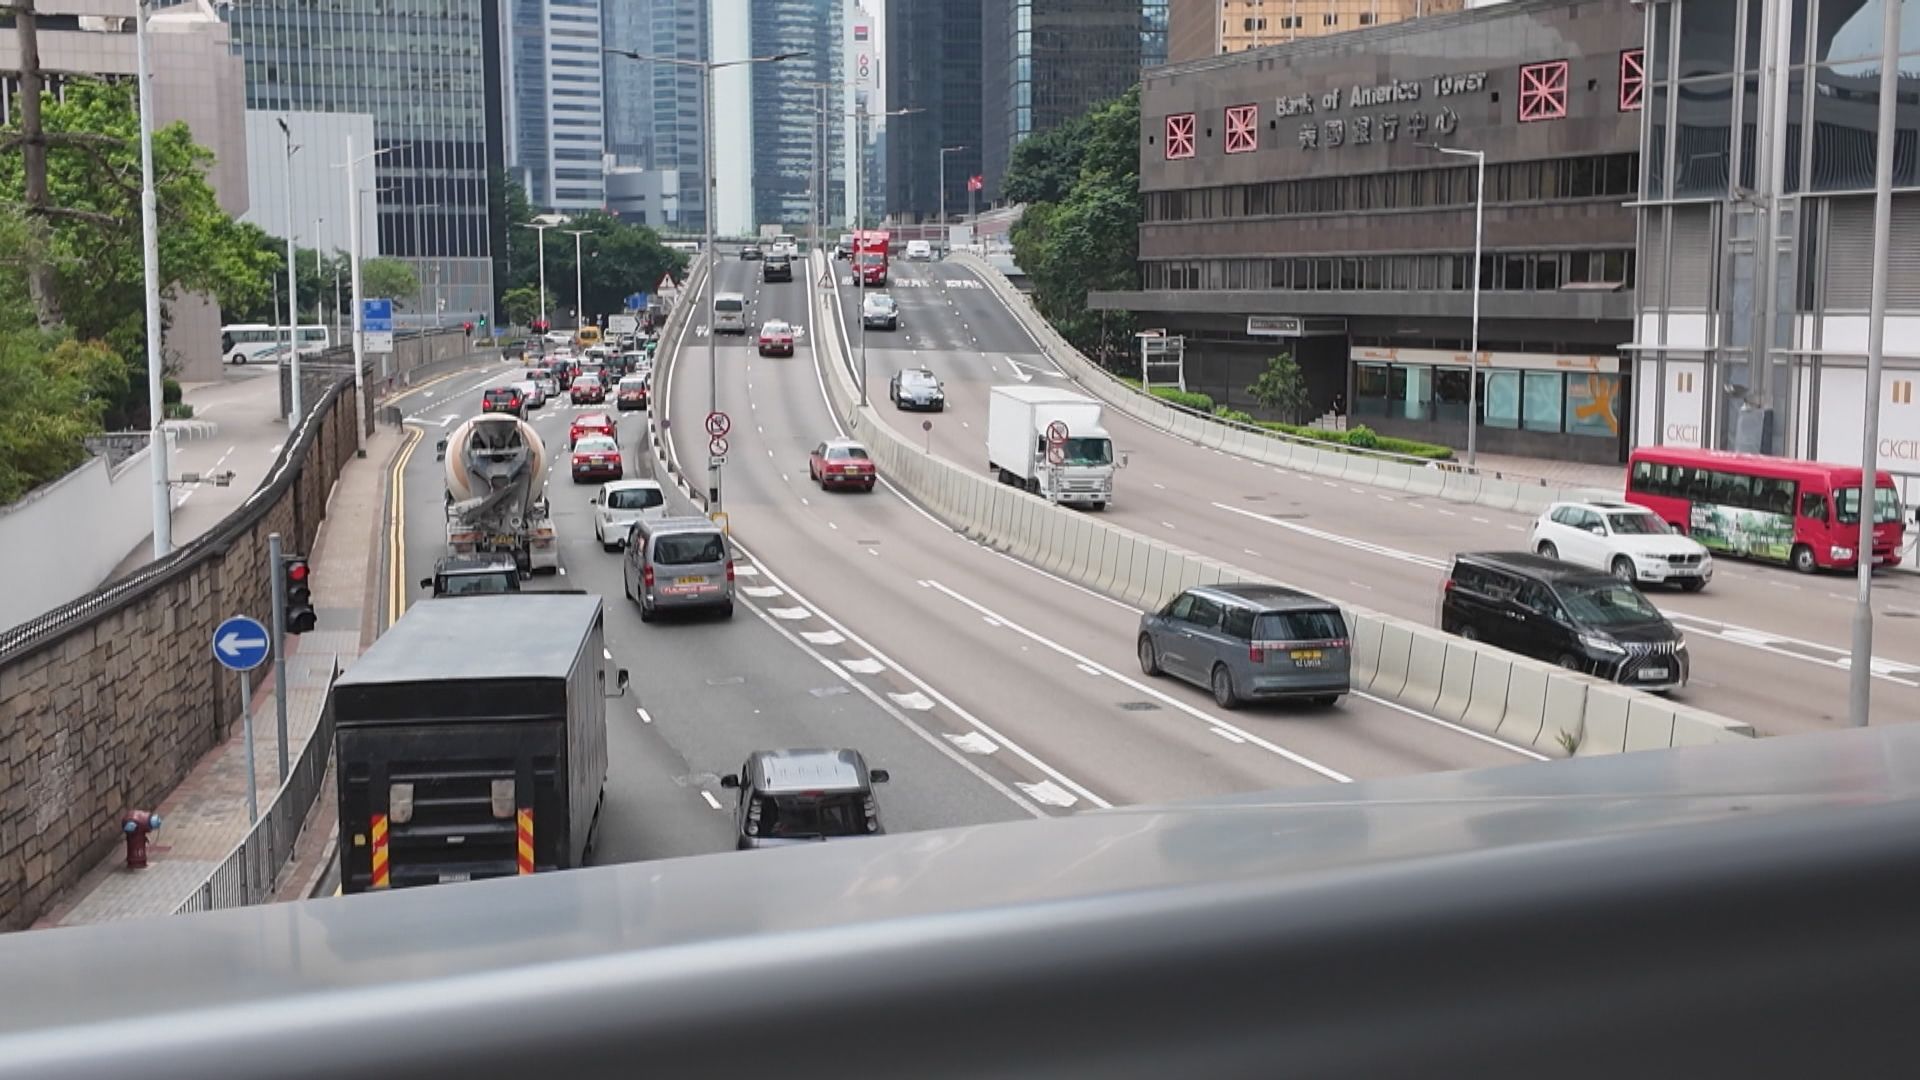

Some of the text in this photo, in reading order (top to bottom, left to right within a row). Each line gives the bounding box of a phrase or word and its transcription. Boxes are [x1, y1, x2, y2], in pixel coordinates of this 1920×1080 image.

[1275, 72, 1487, 117] Bank of America Tower
[1299, 106, 1459, 150] 美國銀行中心
